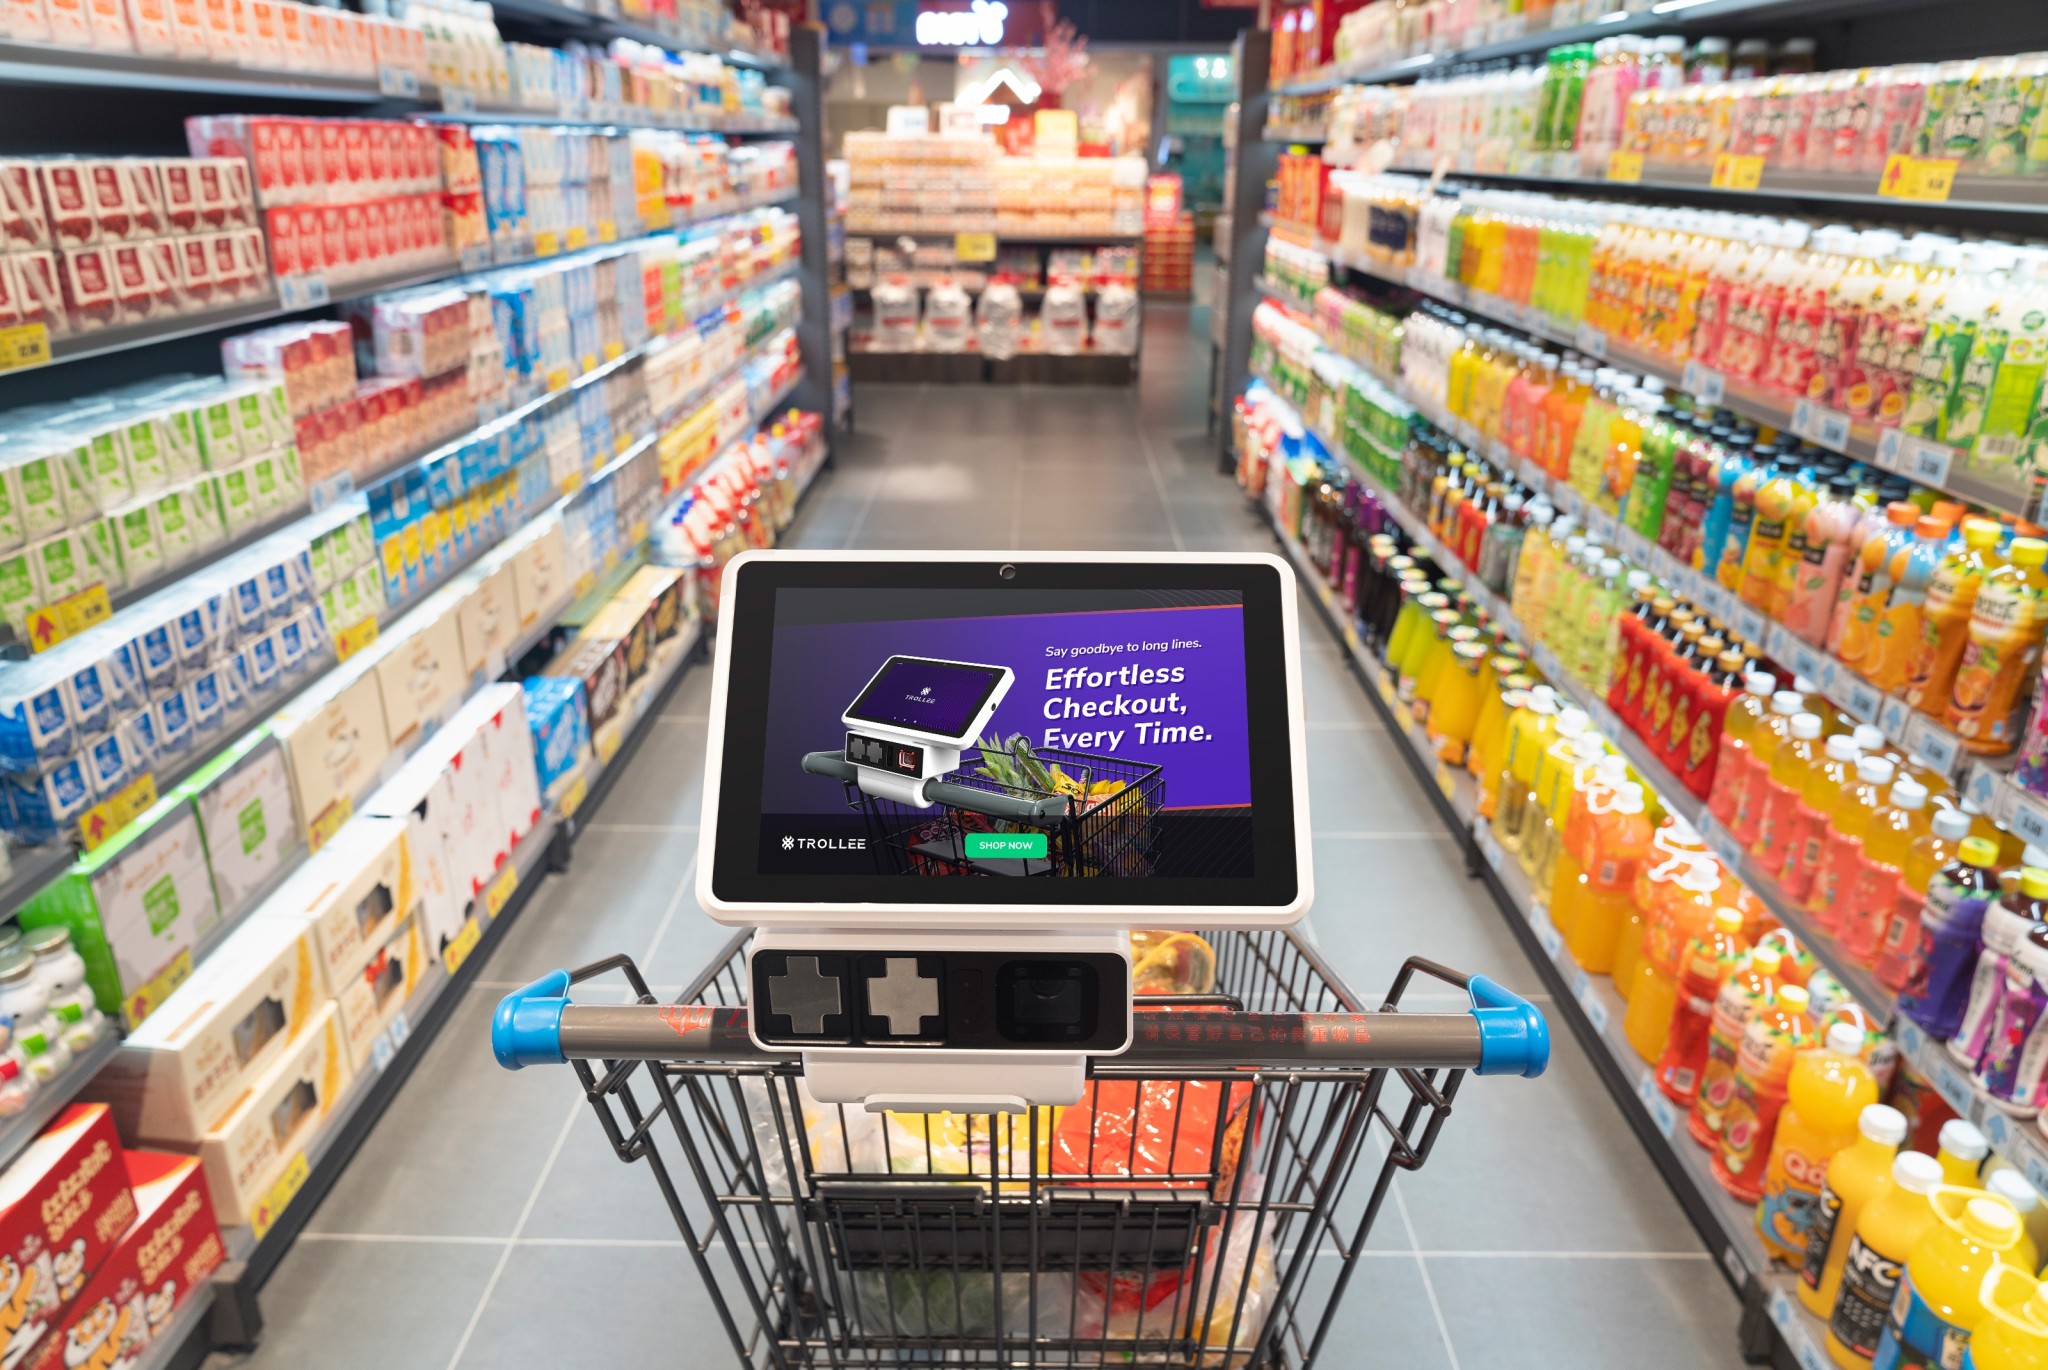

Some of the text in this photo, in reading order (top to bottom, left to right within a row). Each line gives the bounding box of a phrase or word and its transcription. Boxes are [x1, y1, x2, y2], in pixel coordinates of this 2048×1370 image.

[1045, 639, 1202, 658] Say goodbye to long lines.
[1045, 663, 1185, 690] Effortless
[905, 694, 936, 704] TROLLEE
[1043, 693, 1187, 720] Checkout,
[1043, 721, 1212, 752] Every Time.
[797, 838, 866, 849] TROLLEE
[979, 841, 1033, 850] SHOP NOW
[1849, 1235, 1897, 1289] NFC
